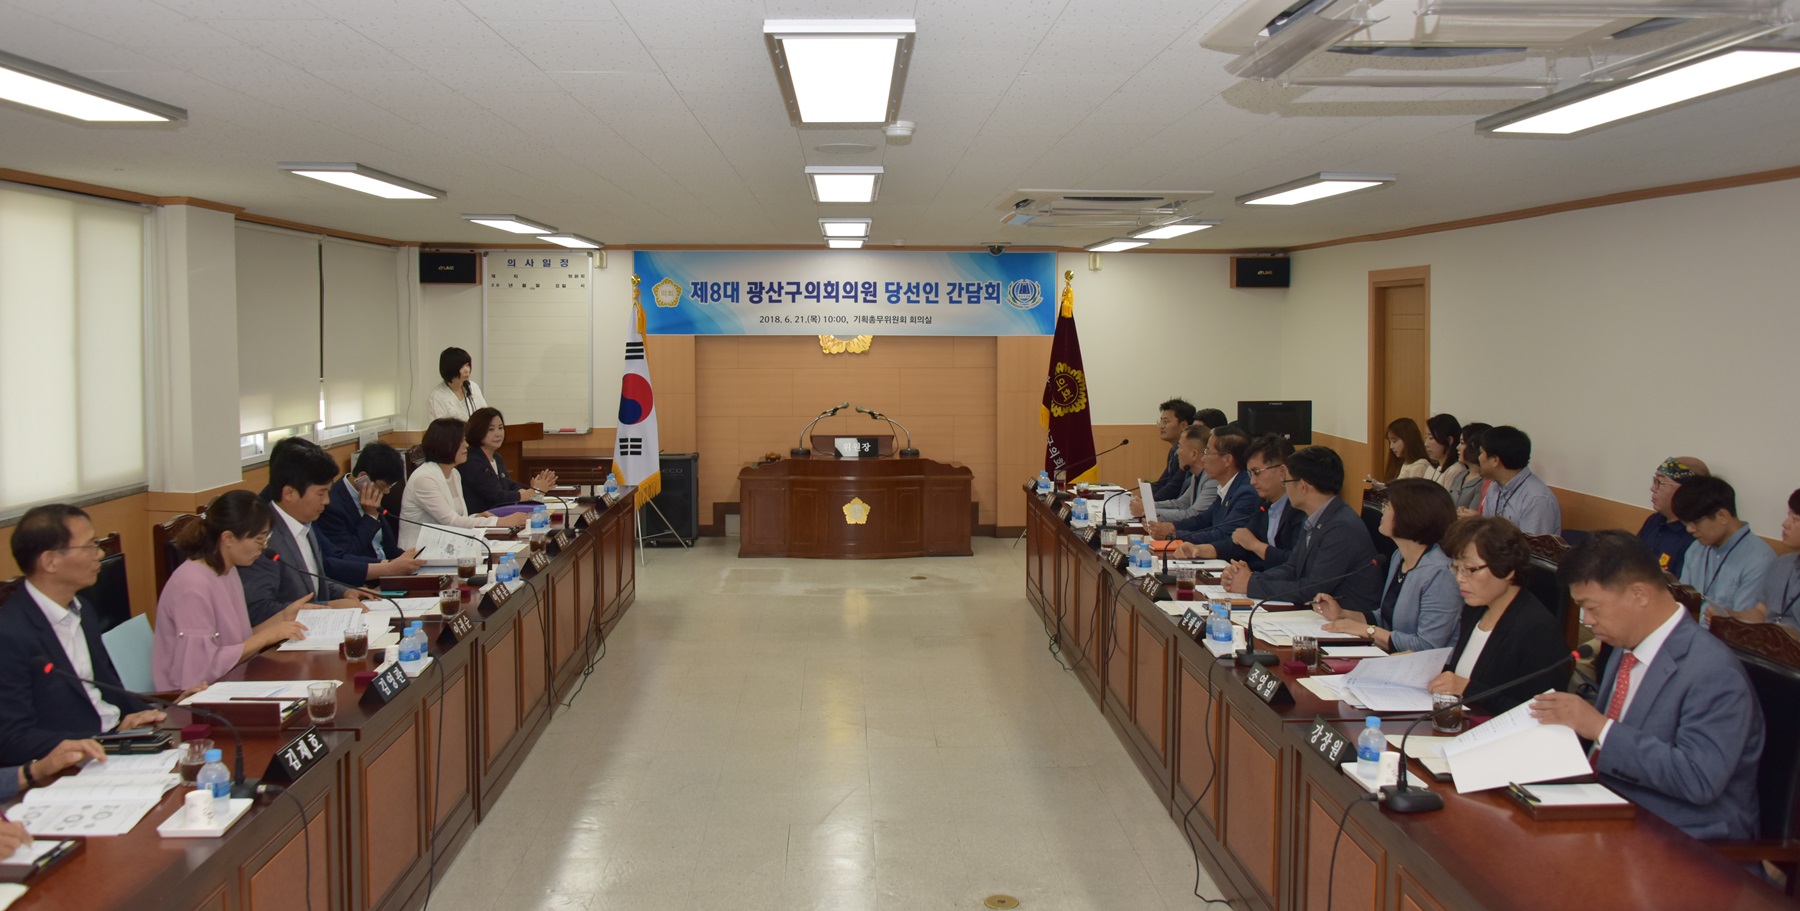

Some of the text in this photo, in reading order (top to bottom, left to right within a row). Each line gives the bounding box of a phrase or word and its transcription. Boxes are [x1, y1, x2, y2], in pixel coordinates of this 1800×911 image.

[507, 258, 569, 268] 의사일정
[690, 281, 740, 304] 제8대
[746, 281, 878, 304] 광산구의회의원
[884, 281, 939, 304] 당선인
[946, 281, 1001, 304] 간담회
[759, 315, 933, 325] 2018. 6. 21.(목) 10:00, 기획총무위원회 회의실
[1047, 429, 1066, 470] 구의회
[453, 615, 472, 636] 이귀순
[378, 666, 406, 696] 김영관
[1248, 668, 1277, 697] 조영임
[284, 733, 323, 771] 김재호
[1310, 724, 1344, 761] 강장원
